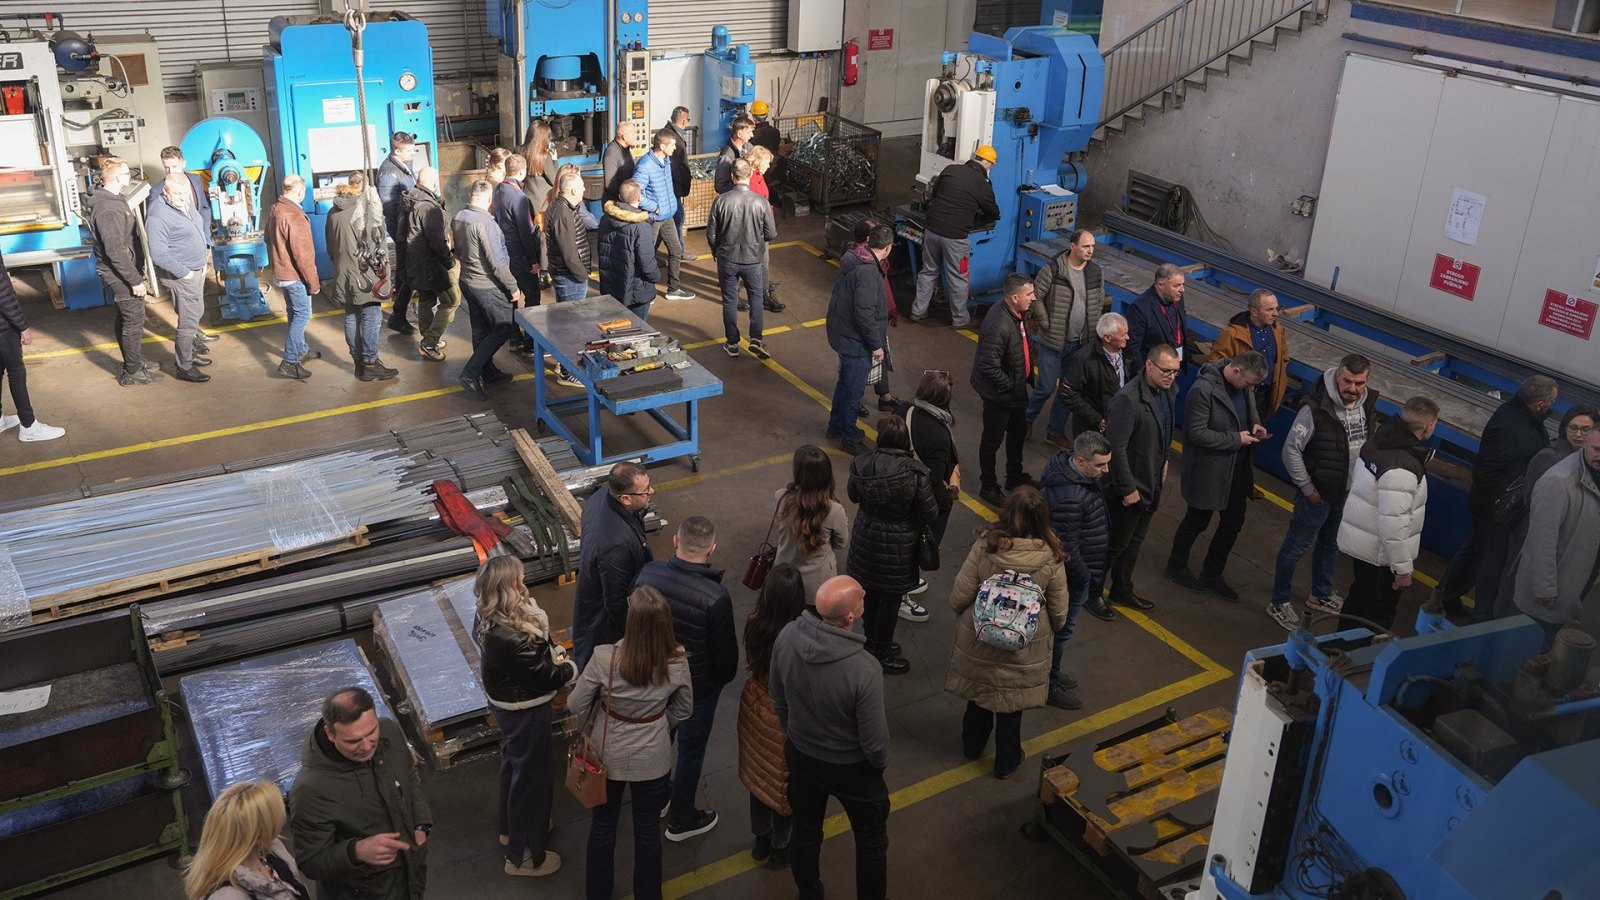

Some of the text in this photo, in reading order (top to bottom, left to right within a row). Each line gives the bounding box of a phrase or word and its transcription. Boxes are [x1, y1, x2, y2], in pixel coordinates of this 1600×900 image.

[1440, 273, 1469, 286] ZABRANJENO
[1446, 270, 1464, 279] STROGO
[1292, 423, 1308, 437] JPN
